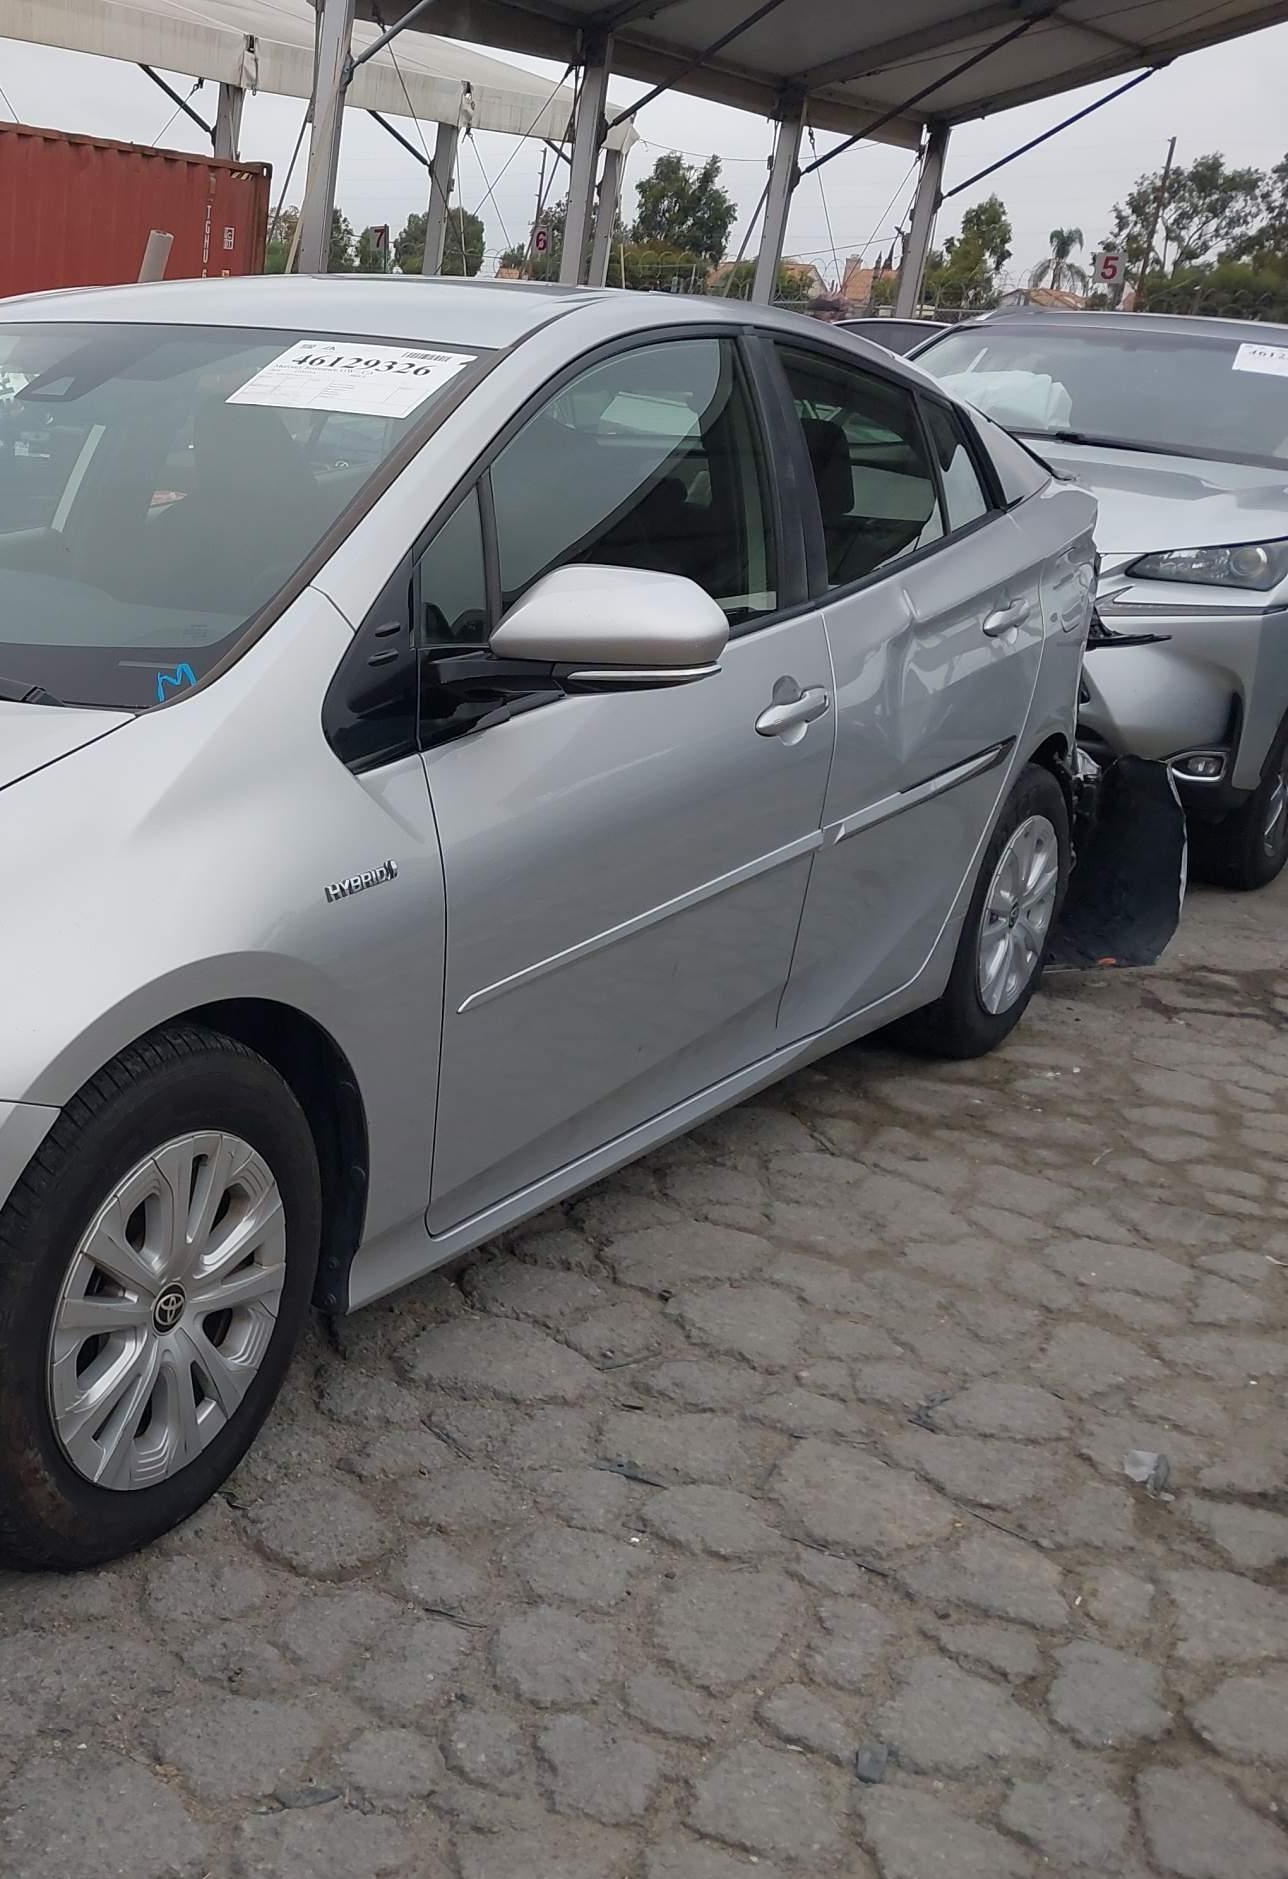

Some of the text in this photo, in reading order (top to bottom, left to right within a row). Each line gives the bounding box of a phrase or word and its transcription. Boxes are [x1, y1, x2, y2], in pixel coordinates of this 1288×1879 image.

[373, 229, 385, 248] 7
[535, 230, 547, 251] 6
[1100, 255, 1120, 280] 5
[292, 353, 432, 377] 46129326
[324, 865, 388, 903] HYBRID
